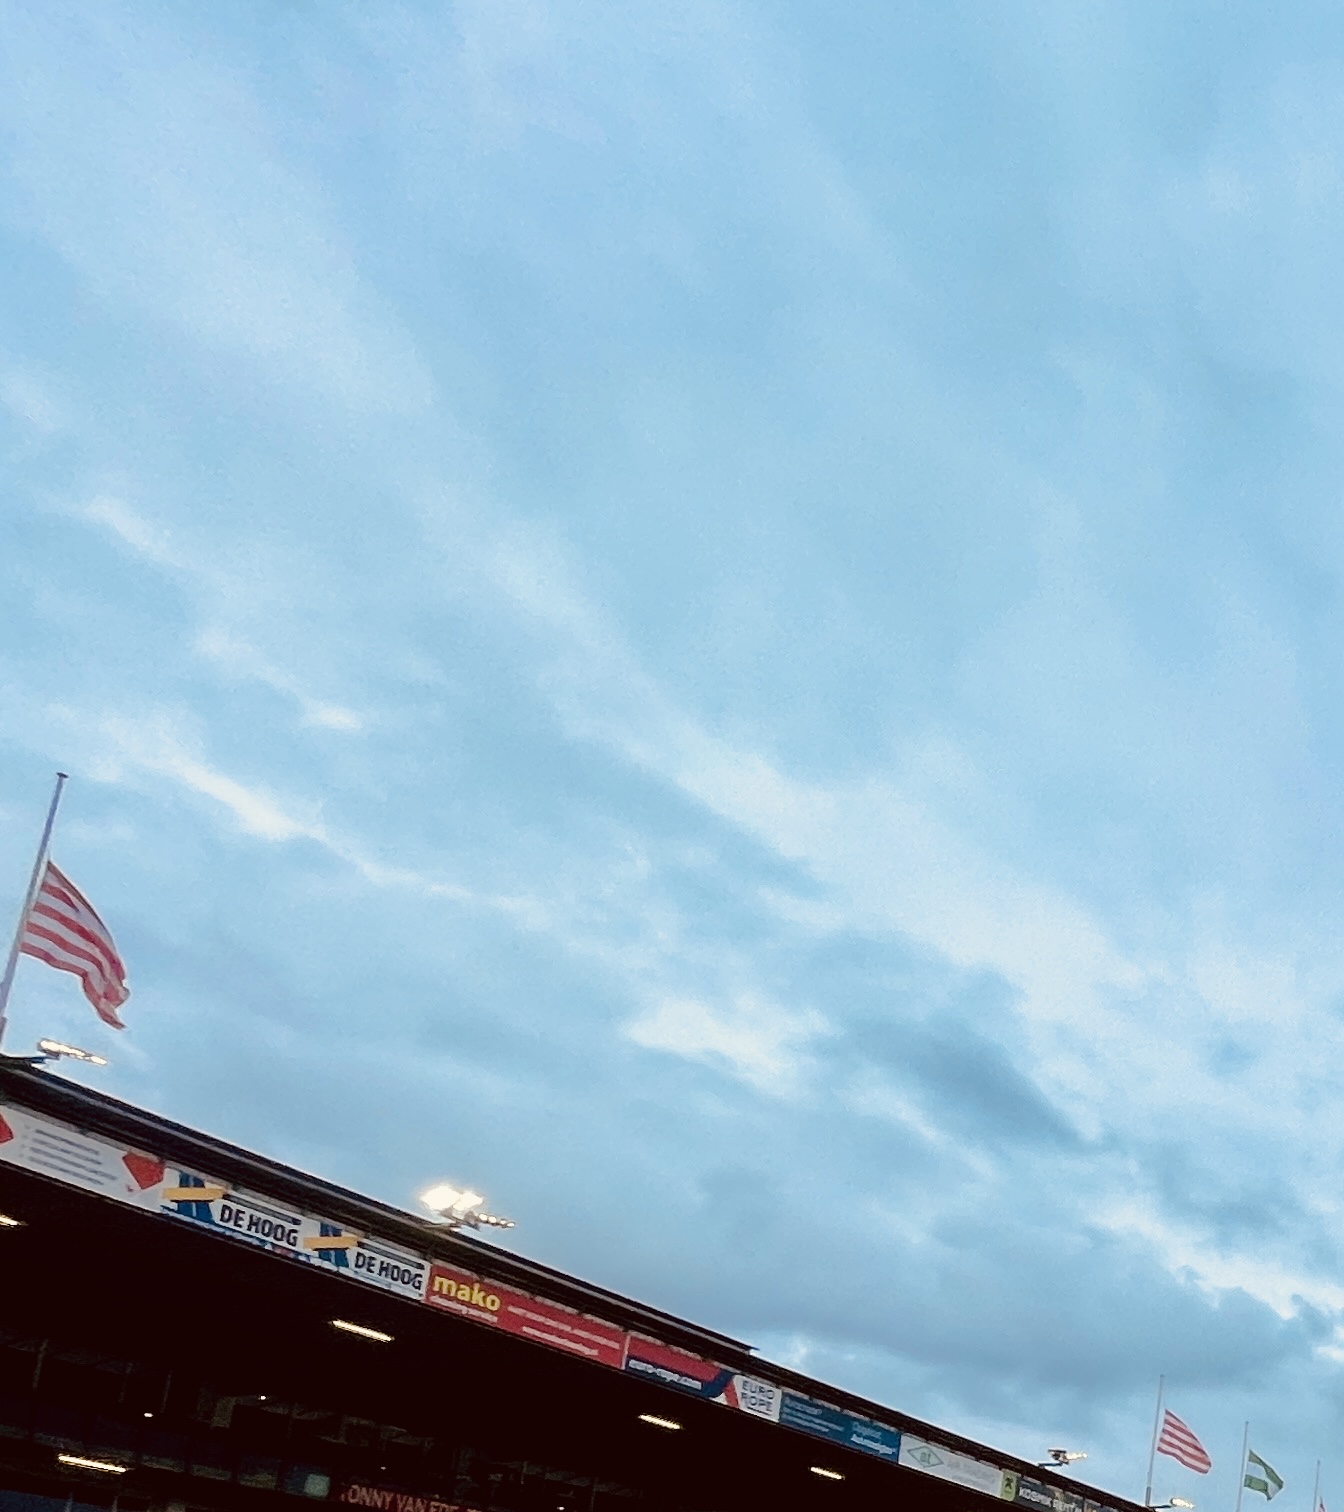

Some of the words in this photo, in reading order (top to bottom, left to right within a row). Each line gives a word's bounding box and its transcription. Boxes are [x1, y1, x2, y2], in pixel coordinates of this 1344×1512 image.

[220, 1204, 245, 1228] DE
[247, 1215, 299, 1247] HOOG
[355, 1252, 376, 1274] DE
[379, 1260, 423, 1290] HOOG
[433, 1275, 501, 1312] mako
[741, 1380, 775, 1400] EURO
